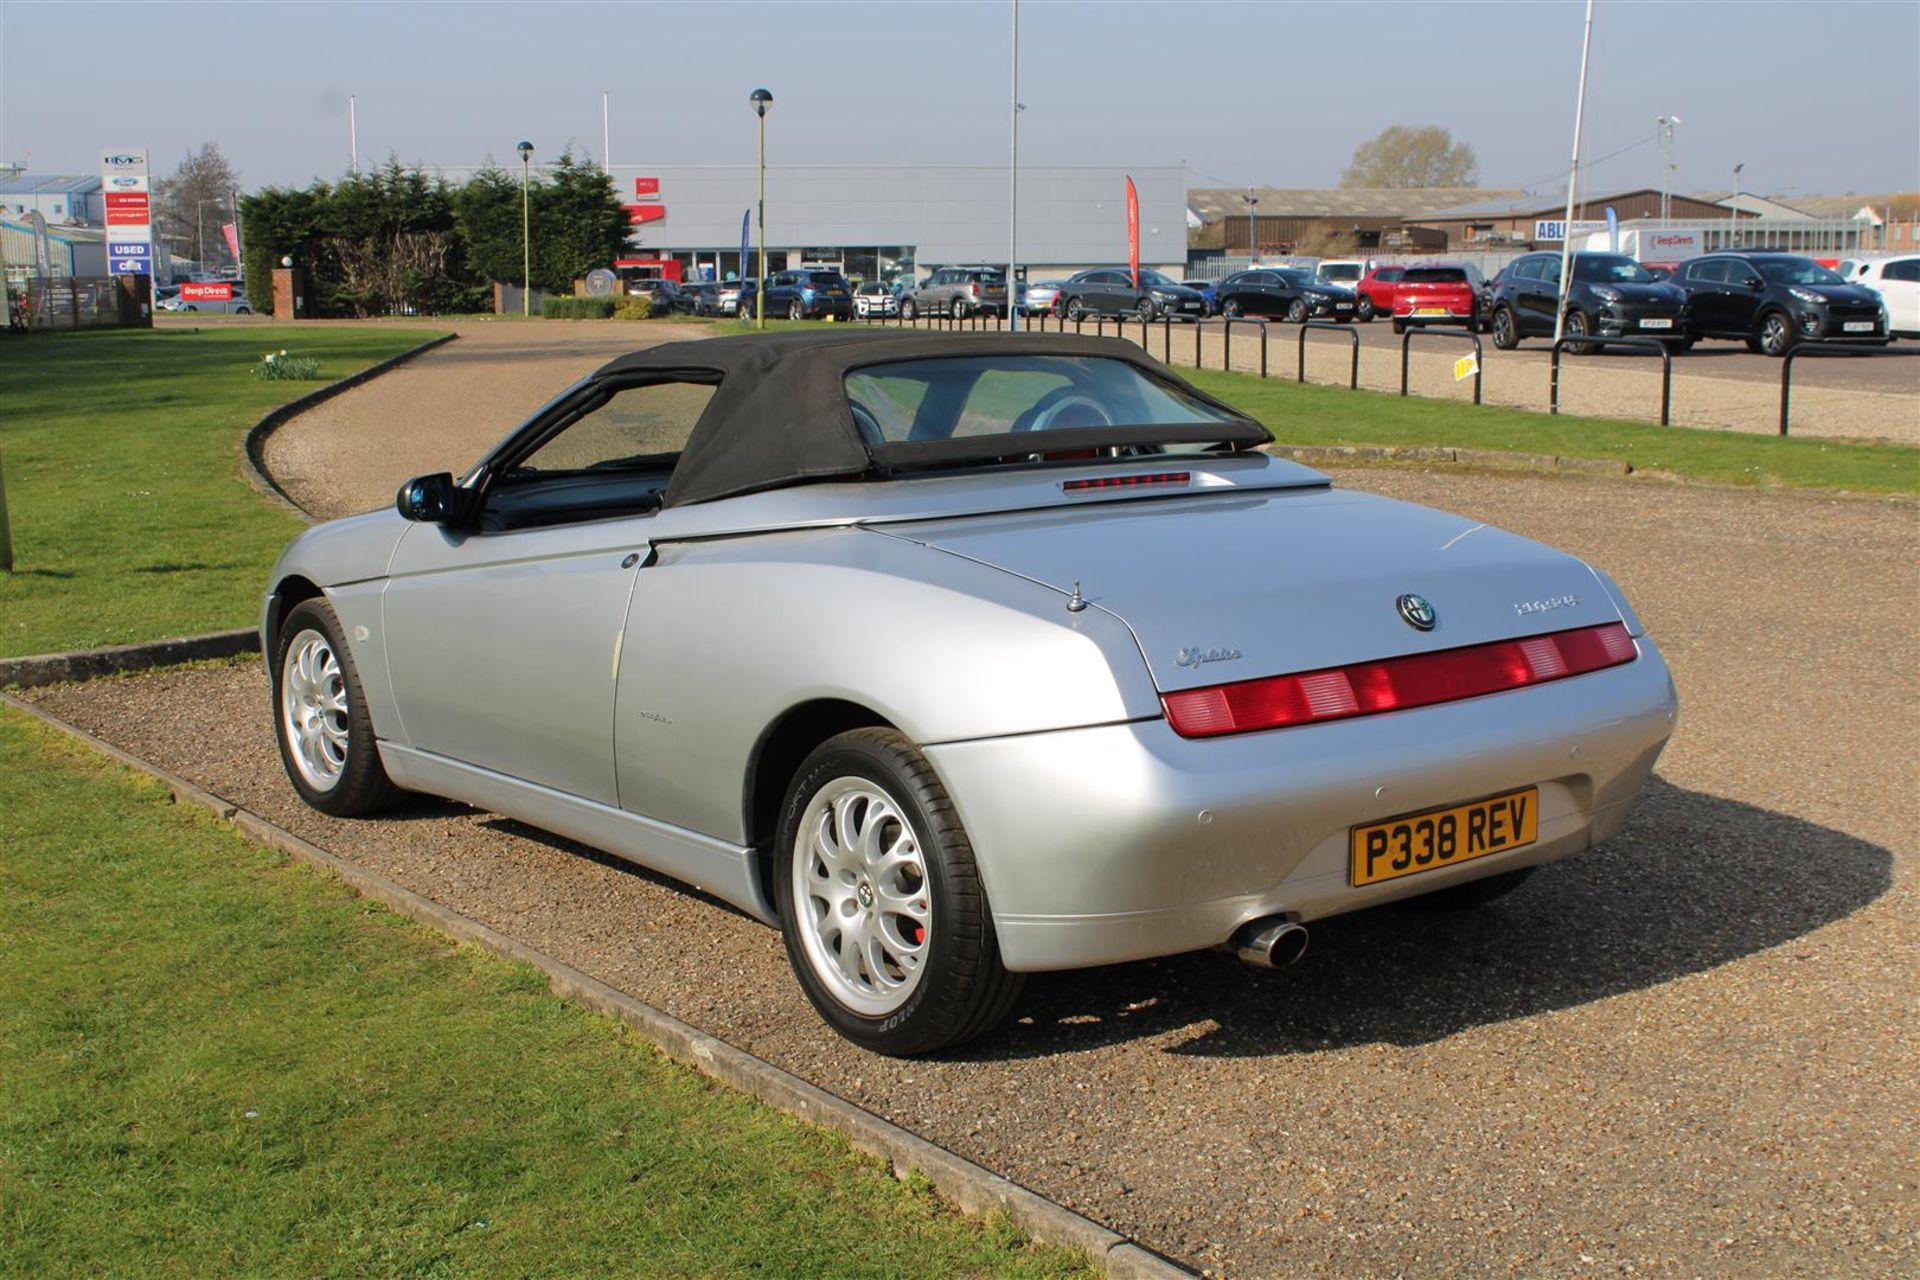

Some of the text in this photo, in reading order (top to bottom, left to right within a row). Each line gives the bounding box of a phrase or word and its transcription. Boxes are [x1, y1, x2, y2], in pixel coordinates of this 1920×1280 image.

[115, 245, 144, 254] USED
[119, 262, 142, 271] CR
[1366, 796, 1527, 877] P338 REV
